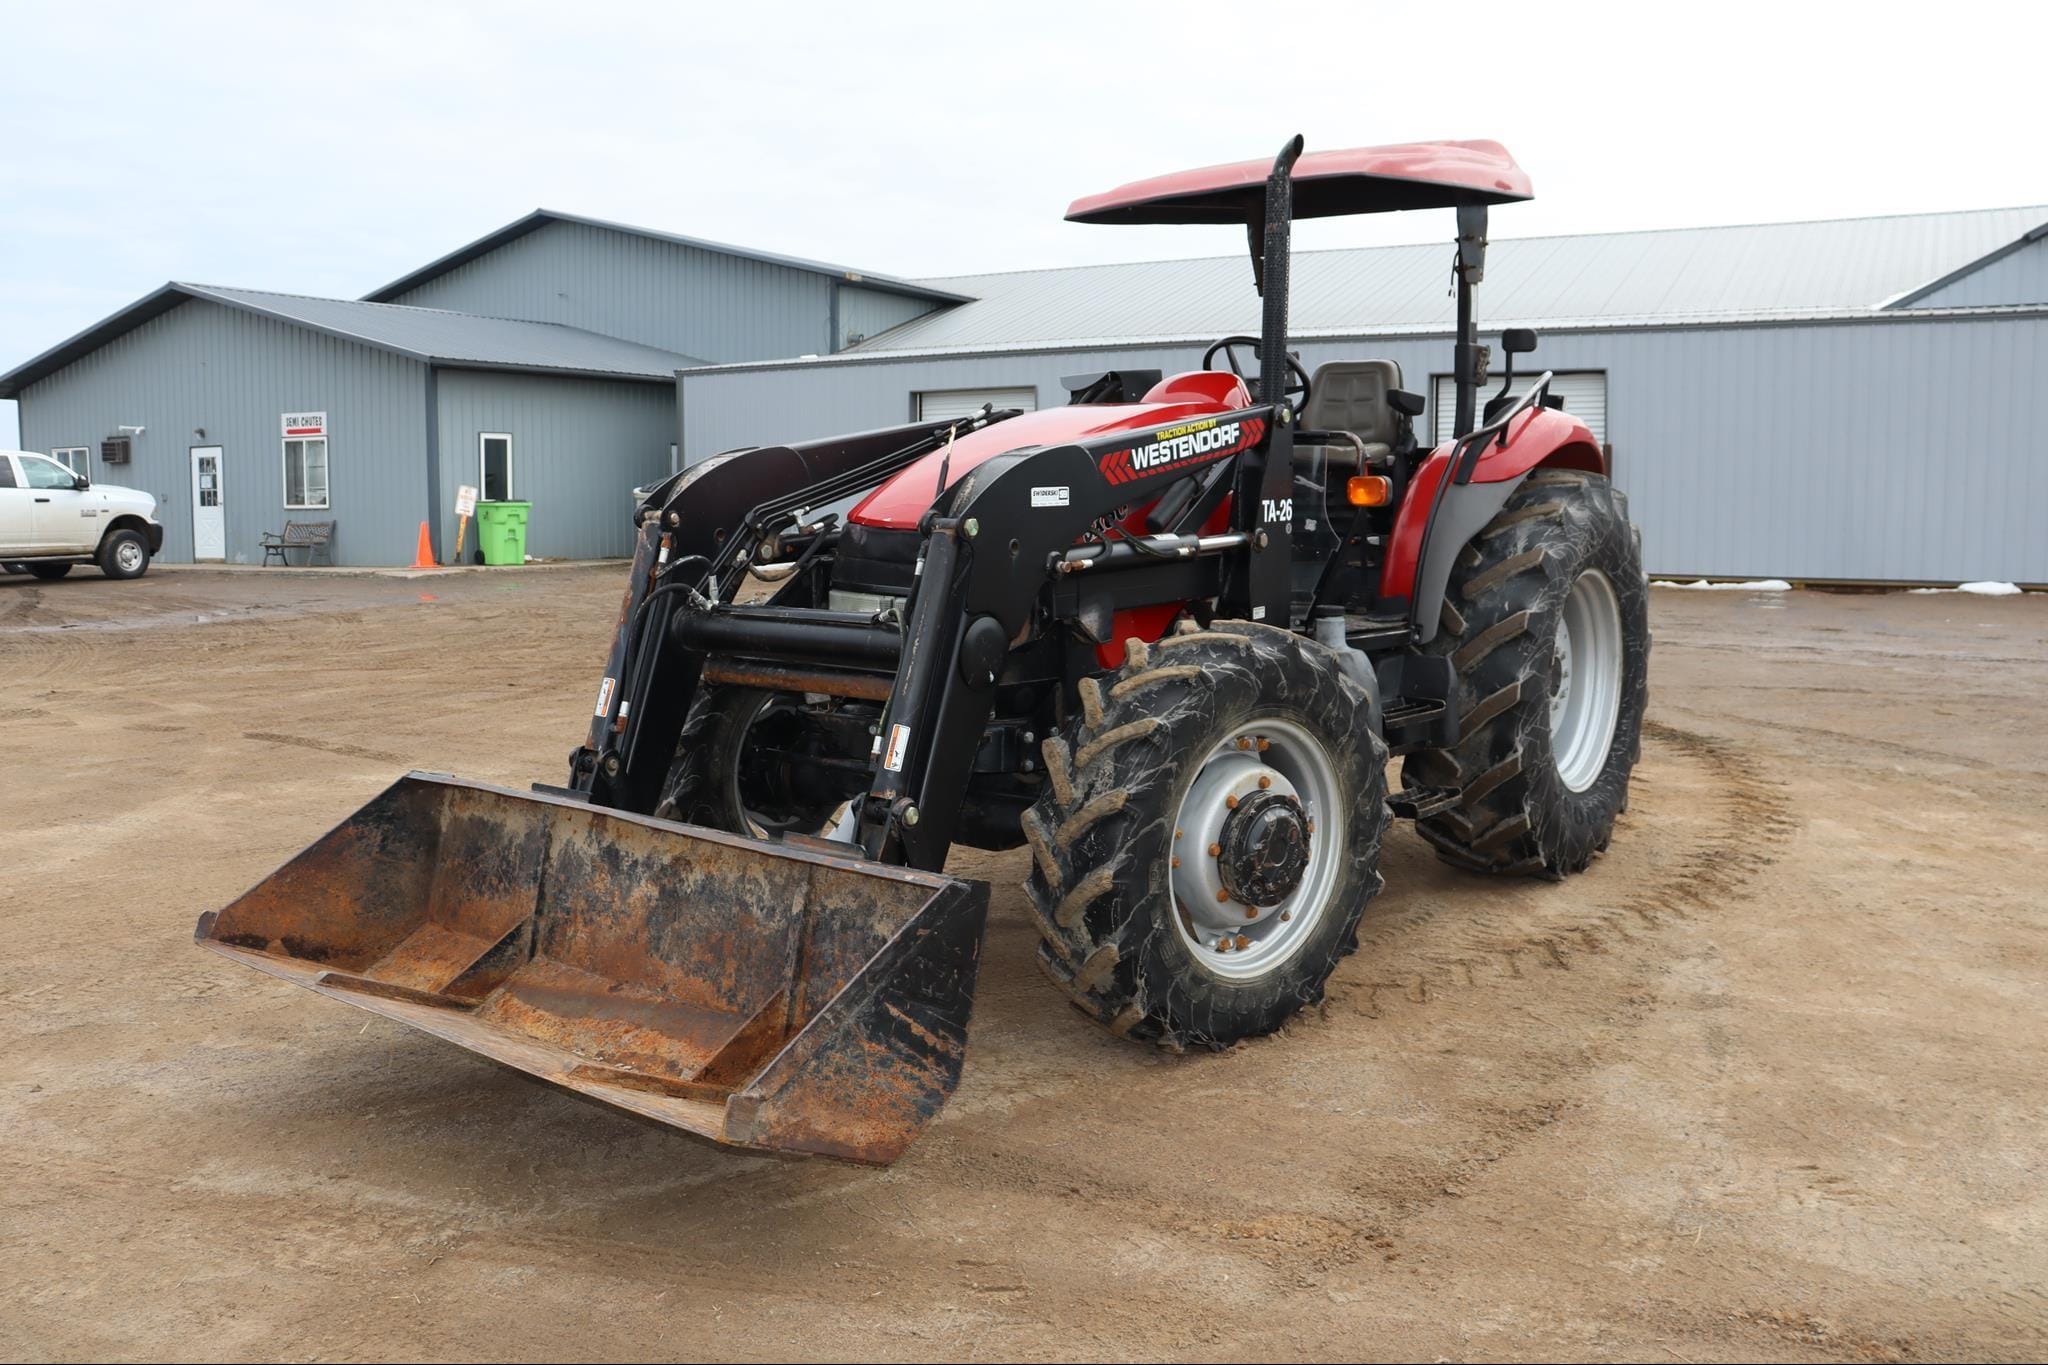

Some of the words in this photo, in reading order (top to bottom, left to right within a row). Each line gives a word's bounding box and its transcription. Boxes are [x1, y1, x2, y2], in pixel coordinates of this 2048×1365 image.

[301, 415, 322, 426] CHUTES
[1156, 425, 1187, 441] TRACTION
[1187, 421, 1208, 434] ACTION
[1207, 418, 1217, 431] BY
[1132, 422, 1239, 470] WESTENDORF
[1262, 499, 1293, 522] TA-26
